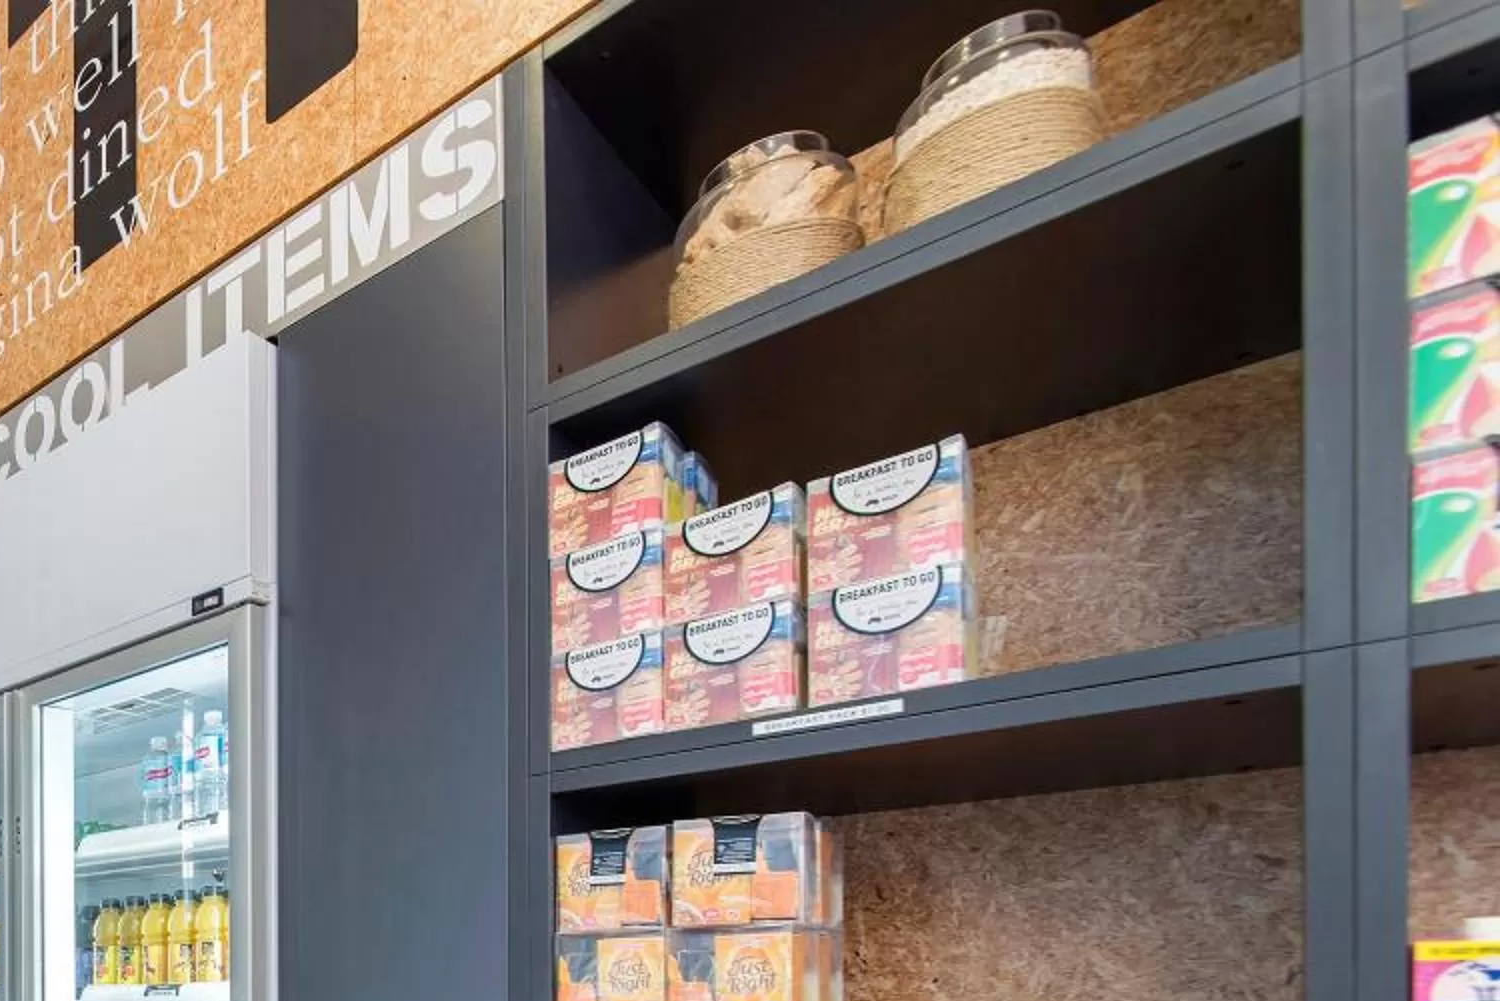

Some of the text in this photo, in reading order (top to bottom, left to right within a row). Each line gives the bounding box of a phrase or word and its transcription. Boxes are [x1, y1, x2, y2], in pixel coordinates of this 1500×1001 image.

[46, 17, 217, 224] dined
[109, 69, 263, 251] wolf
[186, 97, 498, 373] ITEMS
[837, 460, 897, 487] BREAKFAST
[917, 450, 933, 464] GO
[688, 506, 738, 531] BREAKFAST
[839, 578, 900, 604] BREAKFAST
[919, 571, 935, 585] GO
[689, 614, 739, 636] BREAKFAST
